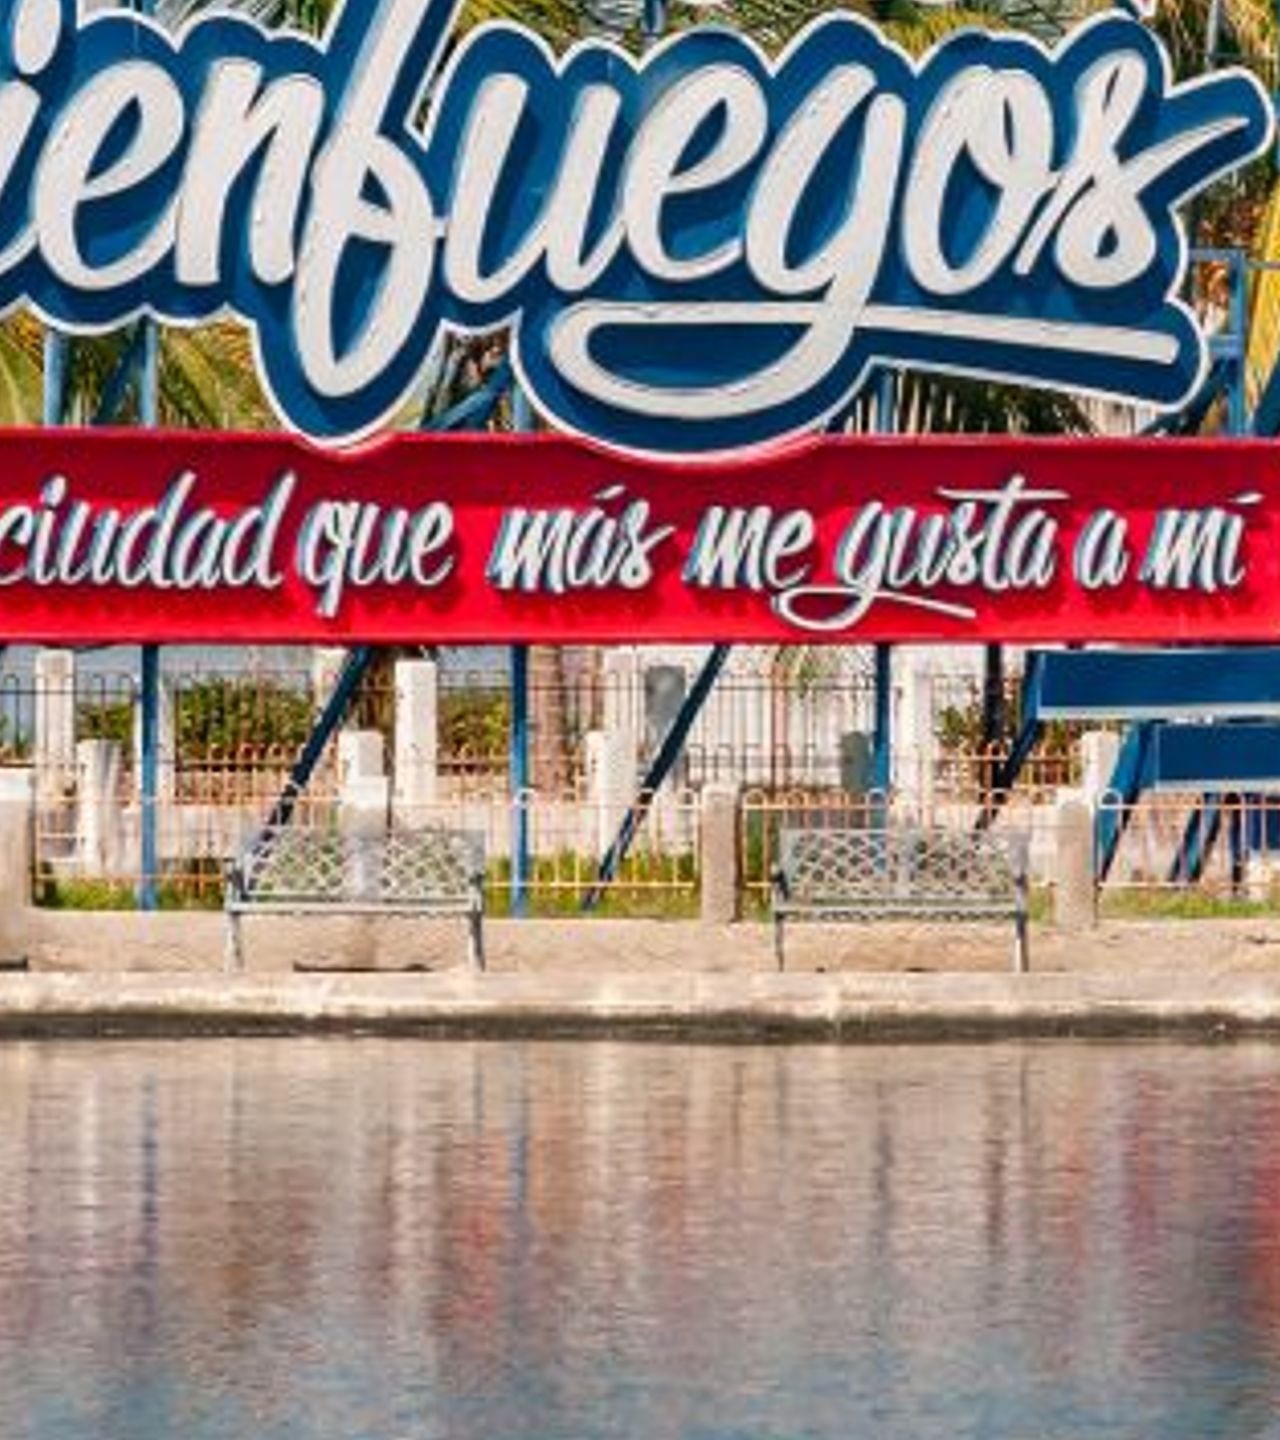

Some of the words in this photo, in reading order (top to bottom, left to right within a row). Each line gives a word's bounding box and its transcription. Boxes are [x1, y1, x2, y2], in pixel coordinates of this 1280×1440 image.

[297, 500, 456, 618] que
[488, 484, 674, 592] más
[684, 502, 816, 592] me
[770, 474, 1070, 632] gusta
[1072, 506, 1128, 588] a
[1138, 490, 1264, 592] mí
